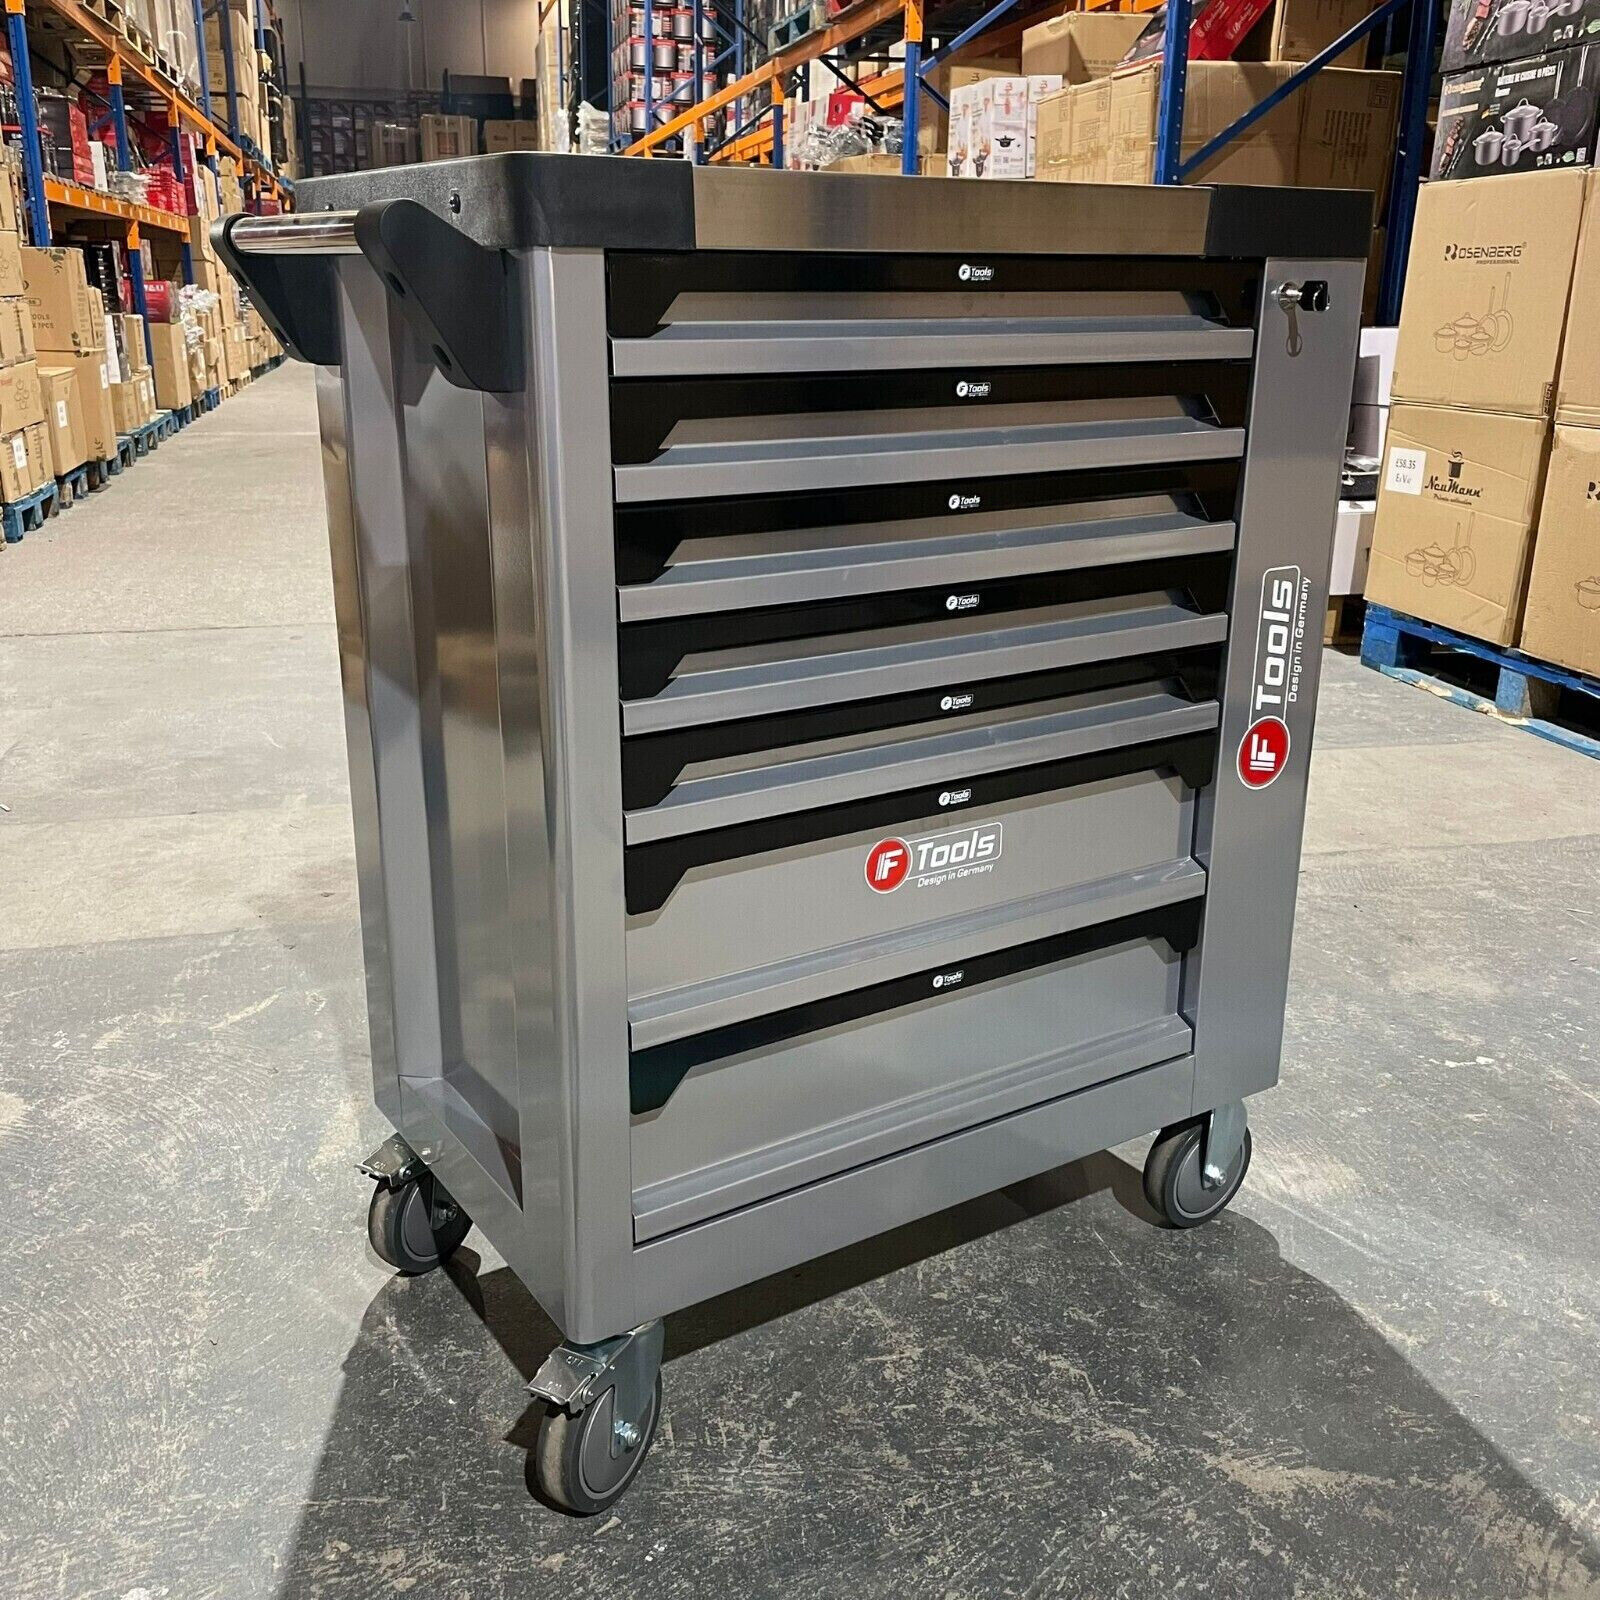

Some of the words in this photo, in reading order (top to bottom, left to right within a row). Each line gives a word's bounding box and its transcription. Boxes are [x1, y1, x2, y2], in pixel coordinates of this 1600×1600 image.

[970, 267, 992, 276] Tools
[968, 384, 989, 392] Tools
[1425, 475, 1482, 498] NeuMann
[960, 495, 981, 504] Tools
[958, 596, 978, 605] Tools
[1295, 577, 1312, 638] Germany
[1256, 579, 1293, 710] Tools
[1294, 640, 1302, 657] in
[1288, 660, 1302, 702] Design
[952, 695, 972, 705] Tools
[950, 790, 970, 800] Tools
[917, 830, 996, 871] Tools
[917, 874, 946, 888] Design
[948, 871, 956, 881] in
[957, 863, 994, 878] Germany
[944, 972, 963, 982] Tools
